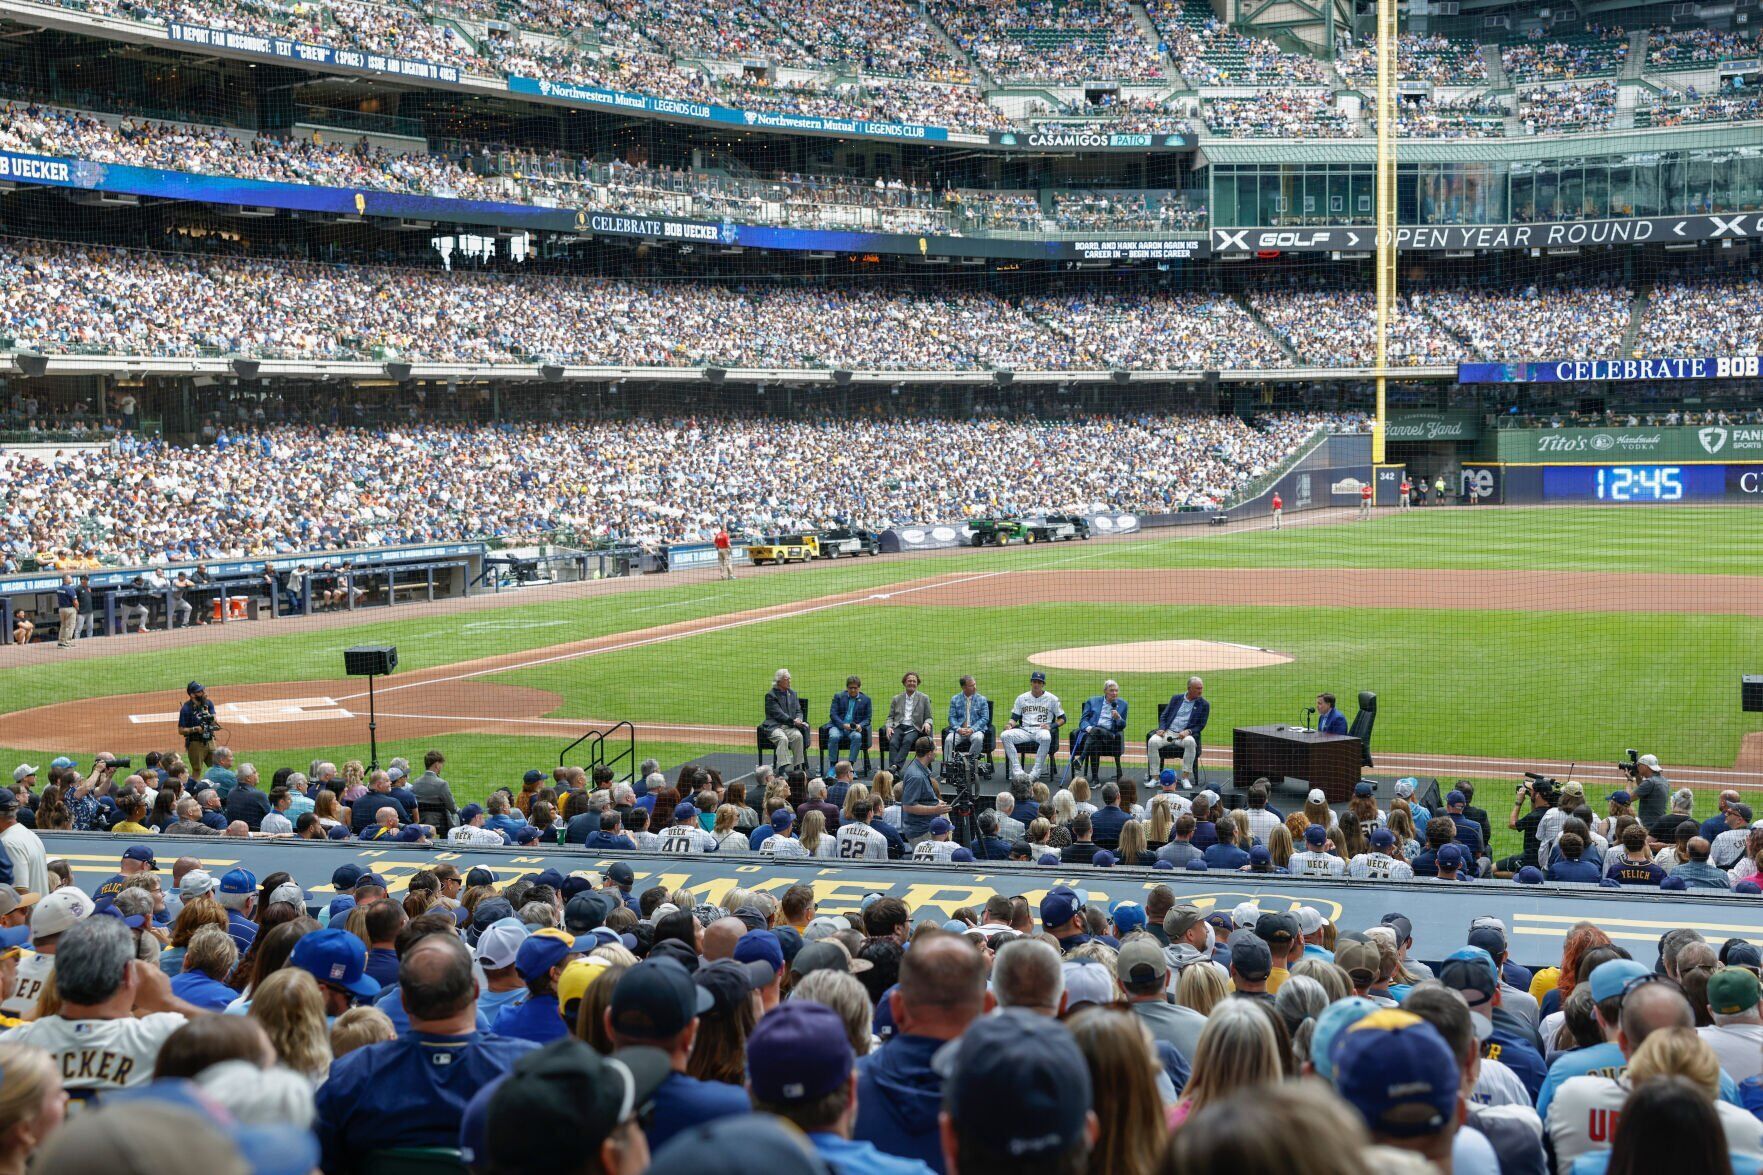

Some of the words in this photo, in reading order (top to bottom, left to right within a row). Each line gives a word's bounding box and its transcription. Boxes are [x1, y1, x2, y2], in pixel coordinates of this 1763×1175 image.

[172, 24, 181, 40] TO
[183, 26, 210, 44] REPORT
[211, 30, 225, 46] FAN
[276, 42, 292, 56] TEXT
[368, 55, 386, 70] ISSUE
[388, 58, 400, 72] AND
[401, 61, 428, 77] LOCATION
[429, 65, 438, 78] TO
[551, 84, 613, 104] Northwestern
[615, 96, 647, 108] Mutual
[654, 100, 690, 114] LEGENDS
[690, 105, 710, 118] CLUB
[758, 114, 822, 130] Northwestern
[824, 120, 857, 132] Mutual
[865, 123, 902, 136] LEGENDS
[903, 126, 924, 138] CLUB
[1028, 134, 1108, 146] CASAMIGOS
[1117, 135, 1146, 146] PATIO
[12, 158, 69, 182] UECKER
[592, 216, 661, 236] CELEBRATE
[664, 222, 684, 236] BOB
[684, 224, 718, 240] UECKER
[1375, 228, 1448, 247] OPEN
[1461, 227, 1532, 246] YEAR
[1548, 220, 1653, 244] ROUND
[1102, 242, 1116, 250] AND
[1138, 242, 1162, 250] AARON
[1164, 242, 1185, 250] AGAIN
[1258, 232, 1330, 246] GOLF
[1084, 250, 1112, 258] CAREER
[1113, 250, 1122, 258] IN
[1129, 250, 1150, 258] BEGIN
[1150, 250, 1162, 258] HIS
[1164, 250, 1190, 258] CAREER
[1556, 359, 1706, 380] CELEBRATE
[1716, 357, 1760, 377] BOB
[1426, 422, 1462, 438] Yard
[1538, 434, 1588, 451] Tito's
[1616, 434, 1661, 444] Handmade
[1380, 472, 1394, 480] 342
[1598, 468, 1682, 500] 12:45
[1022, 706, 1048, 714] BREWERS
[454, 832, 473, 840] UECK
[668, 828, 686, 836] UECK
[662, 838, 690, 852] 40
[840, 839, 866, 858] 22
[1307, 860, 1329, 870] UECK
[1367, 858, 1388, 869] UECK
[1621, 870, 1650, 880] YELICH
